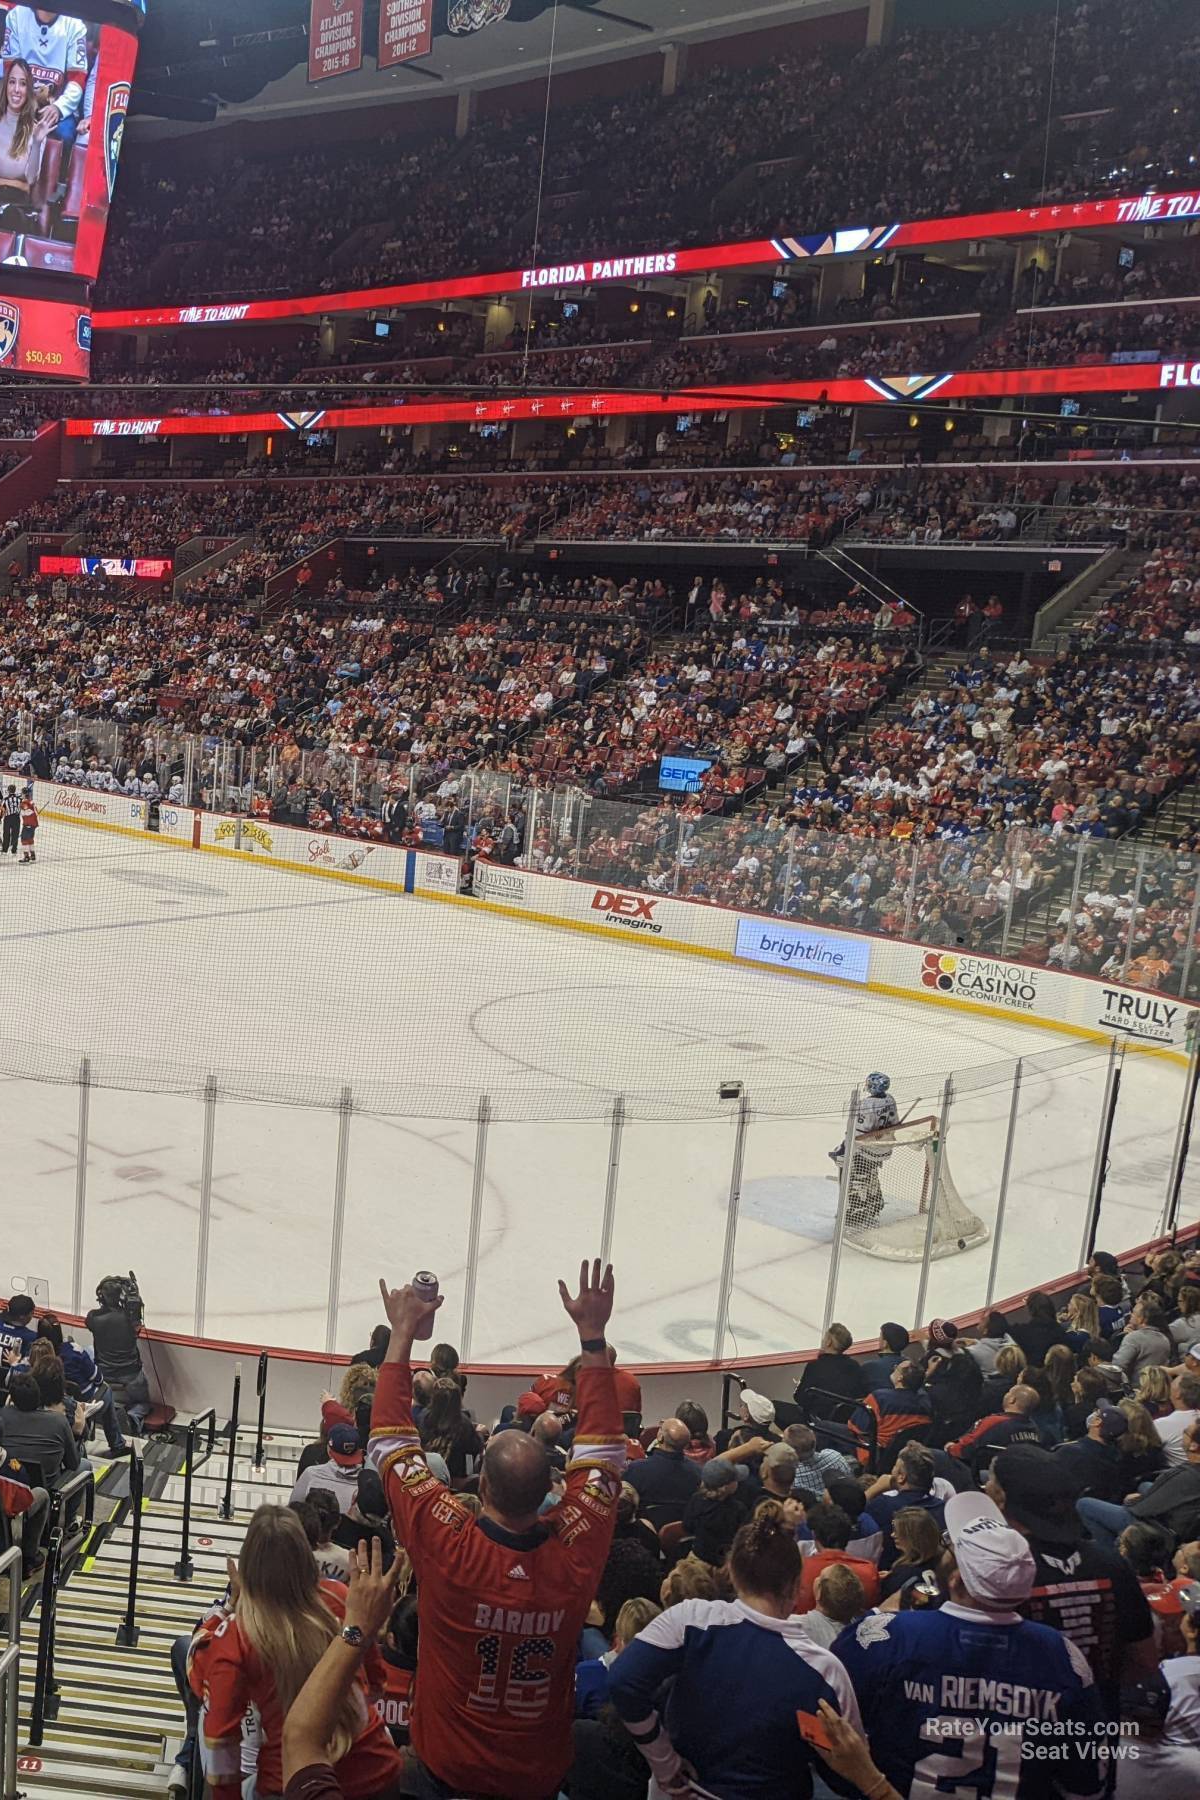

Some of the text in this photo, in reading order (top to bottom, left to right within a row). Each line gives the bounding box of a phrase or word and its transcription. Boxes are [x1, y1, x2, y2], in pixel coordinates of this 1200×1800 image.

[320, 11, 353, 31] ATLANTIC
[390, 8, 421, 28] DIVISION
[320, 25, 351, 43] DIVISION
[384, 20, 425, 44] CHAMPIONS
[315, 38, 356, 59] CHAMPIONS
[391, 39, 416, 57] 2011-12
[322, 54, 349, 72] 2015-16
[1117, 196, 1164, 221] TIME
[1167, 196, 1194, 217] TO
[522, 253, 677, 287] FLORIDA PANTHERS
[179, 304, 250, 323] TIME TO HUNT
[25, 349, 62, 365] $50,430
[93, 420, 162, 435] TIME TO HUNT
[661, 767, 697, 781] GEIC
[54, 790, 107, 815] Bally SPORTS
[591, 890, 659, 920] DEX
[605, 912, 663, 933] imaging
[759, 934, 845, 966] brightline
[958, 957, 1039, 986] SEMINOLE
[958, 972, 1036, 1001] CASINO
[956, 988, 1034, 1010] COCONUT CREEK
[1102, 989, 1178, 1028] TRULY
[1104, 1014, 1130, 1025] HARD
[475, 1603, 566, 1635] BARKOV
[467, 1634, 556, 1719] 16
[904, 1675, 1062, 1720] VAN RIEMSDYK
[20, 1760, 37, 1771] 11
